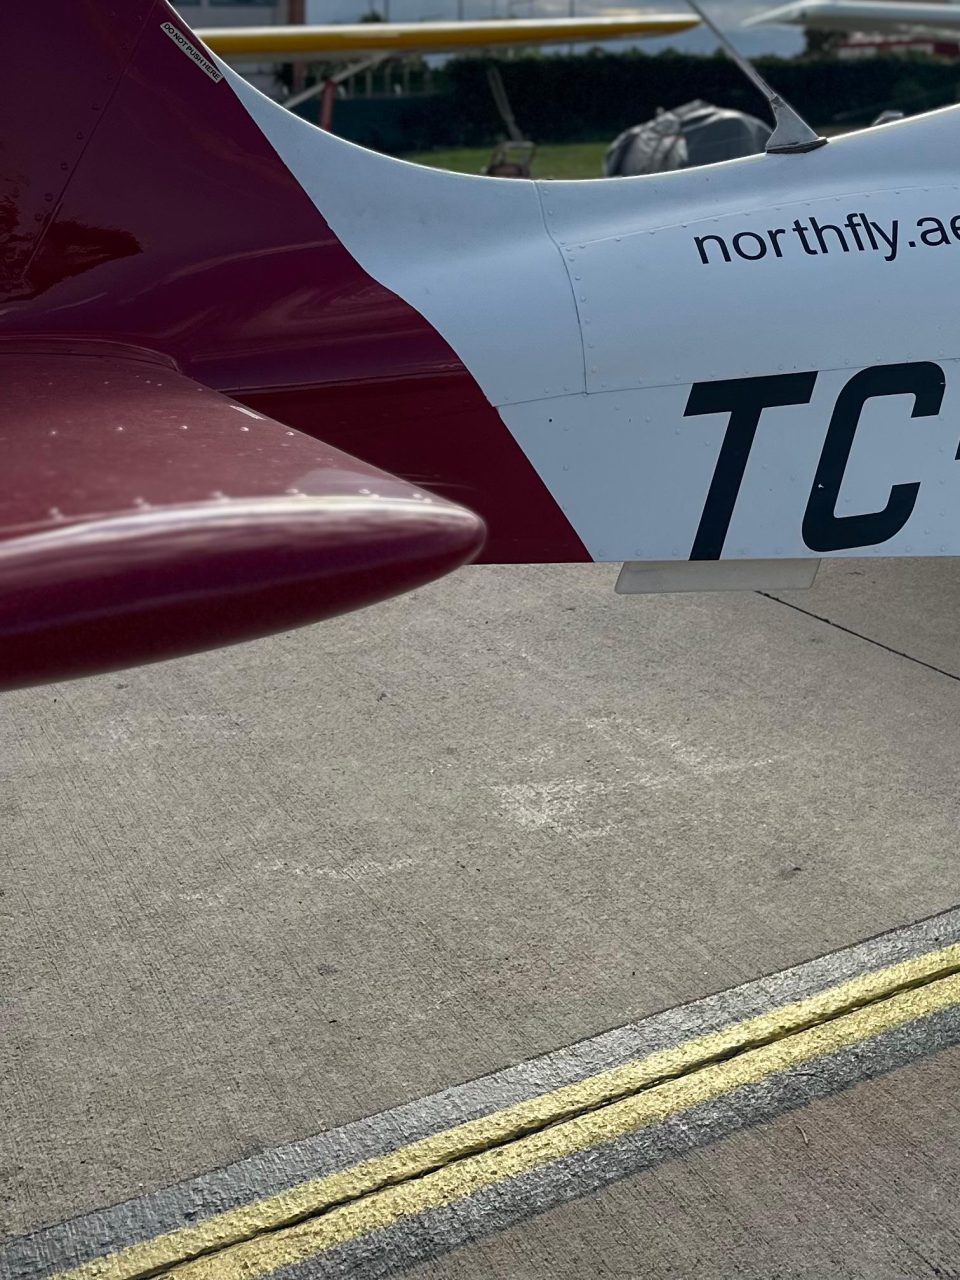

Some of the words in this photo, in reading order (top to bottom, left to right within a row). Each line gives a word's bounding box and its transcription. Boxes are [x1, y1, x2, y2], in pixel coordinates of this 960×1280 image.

[163, 23, 175, 35] DO
[173, 32, 189, 47] NOT
[185, 45, 204, 64] PUSH
[202, 61, 221, 81] HERE
